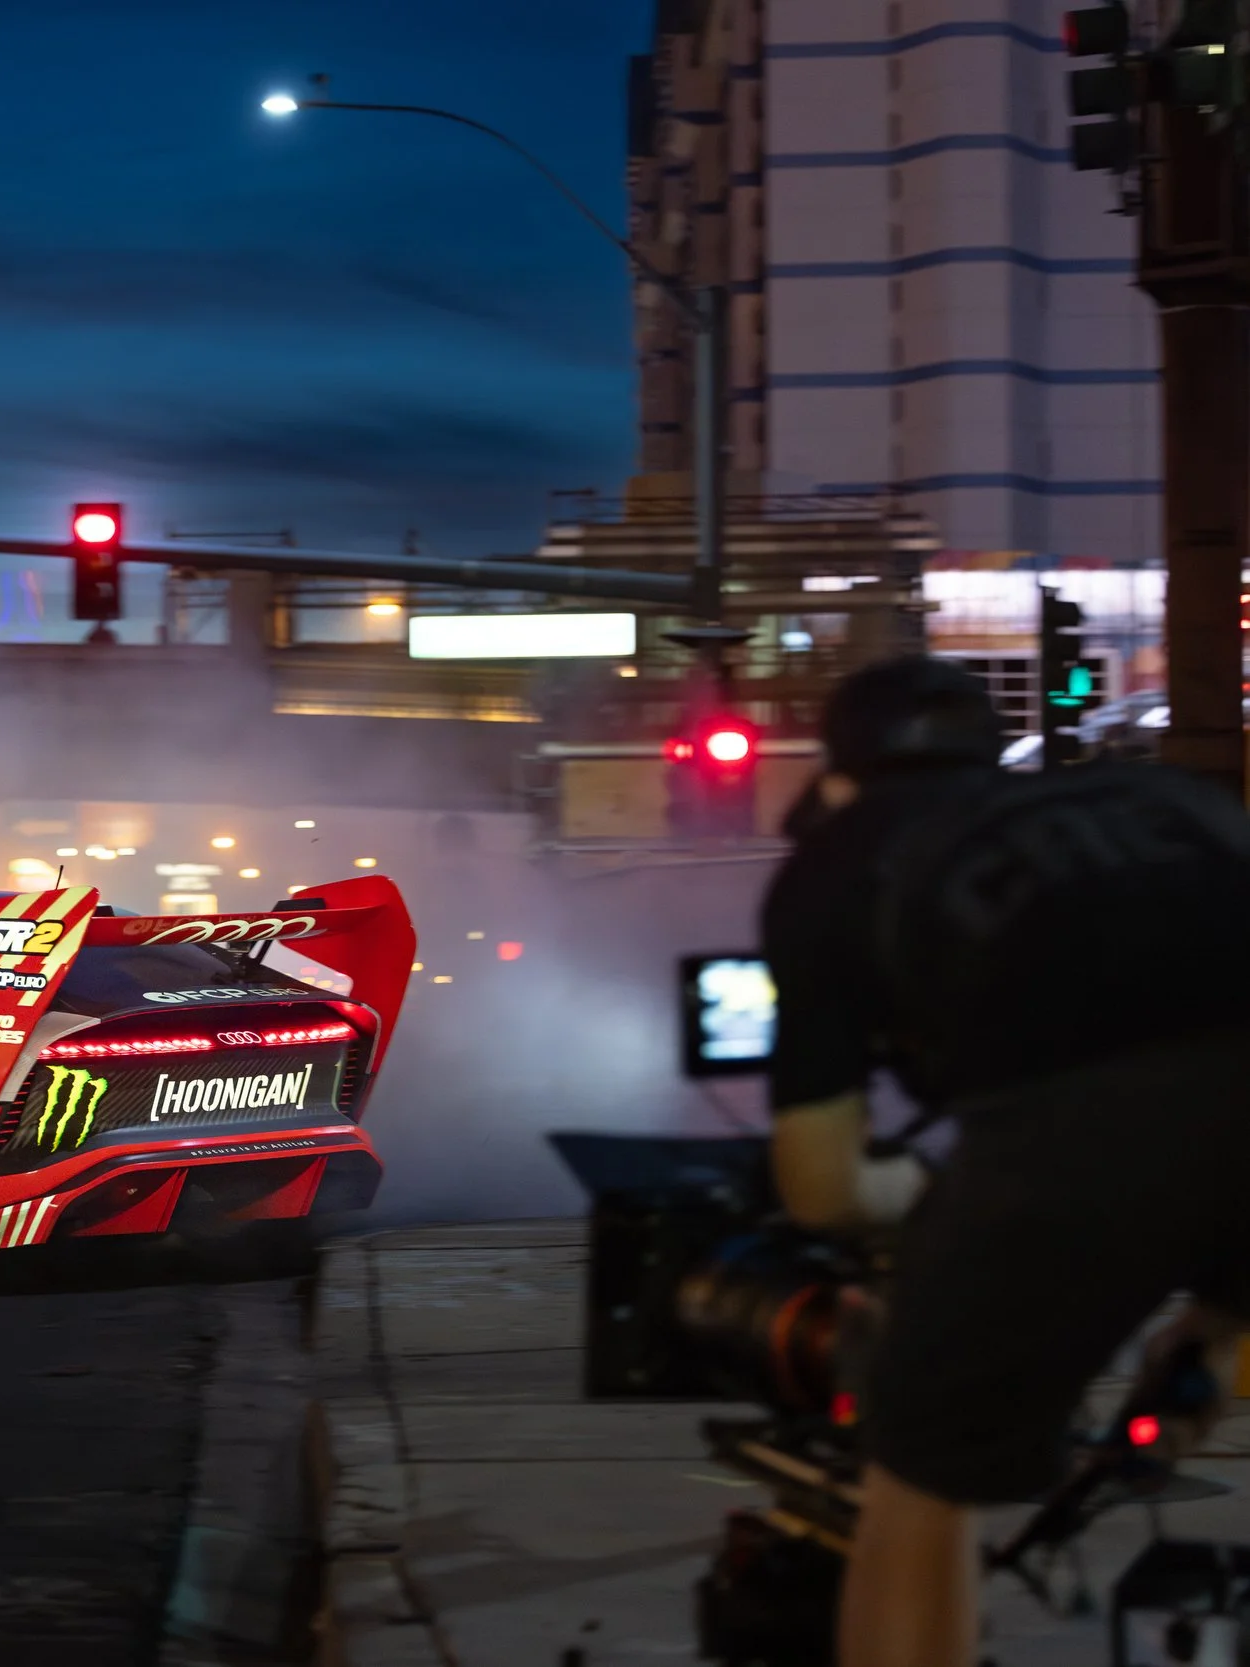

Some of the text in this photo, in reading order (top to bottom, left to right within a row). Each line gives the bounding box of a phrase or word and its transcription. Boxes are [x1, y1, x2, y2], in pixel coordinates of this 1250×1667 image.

[14, 975, 47, 989] EURO
[176, 988, 309, 1001] FCP EURO
[271, 1140, 316, 1149] Attitude
